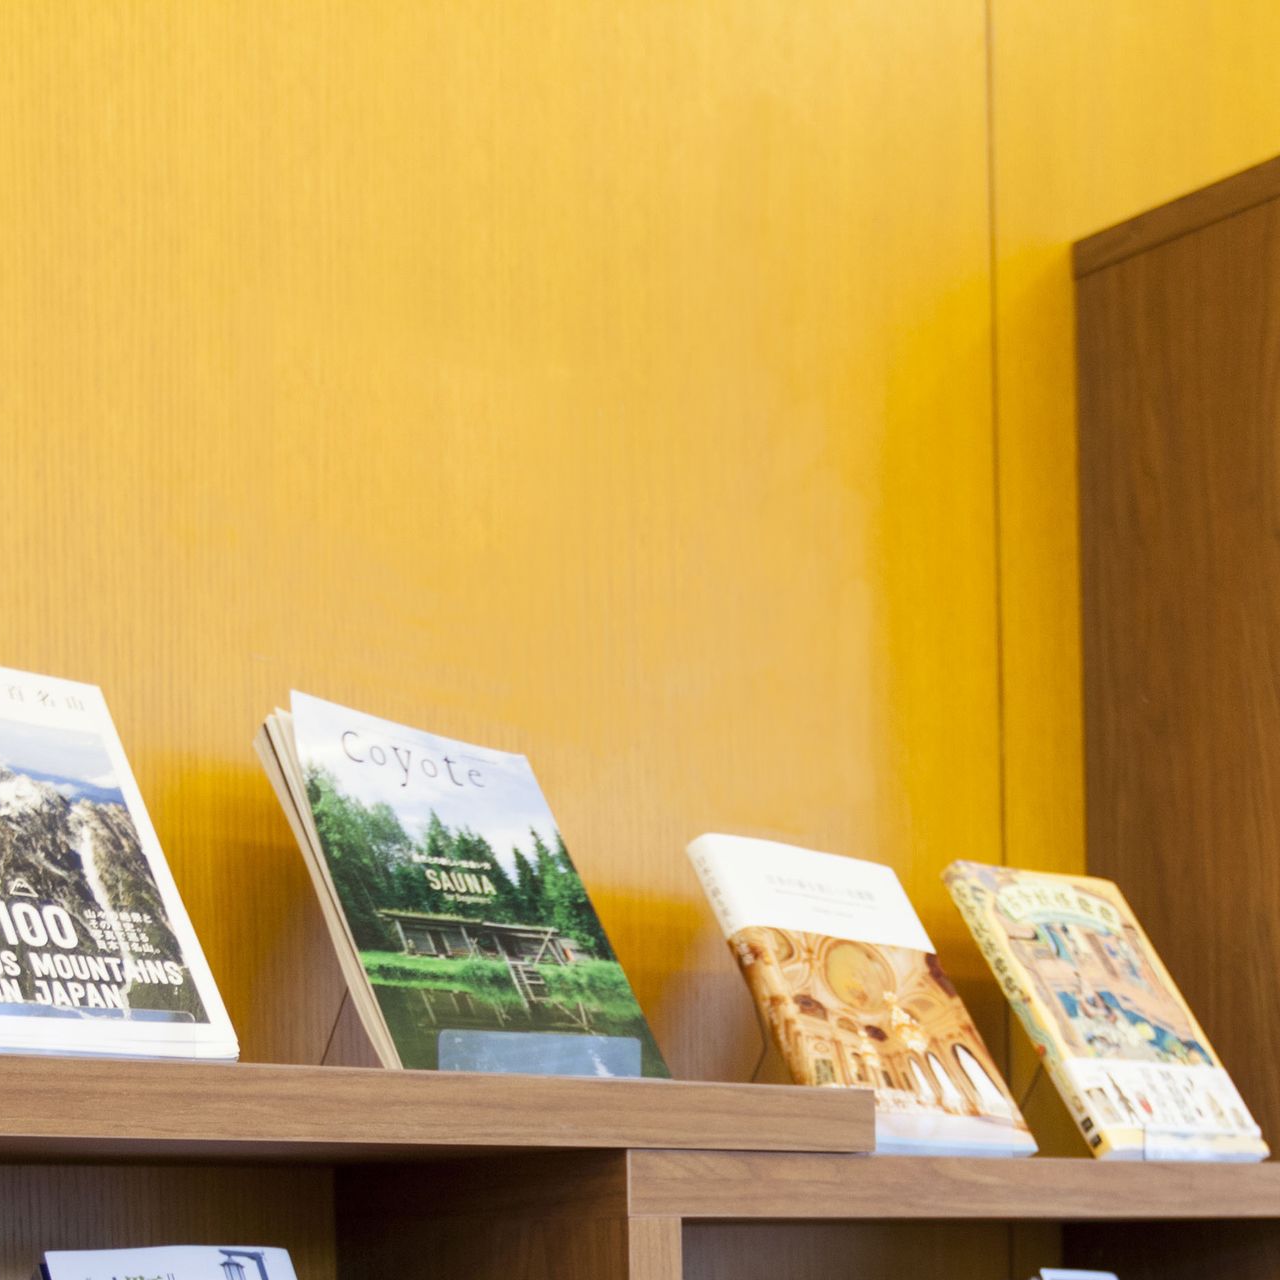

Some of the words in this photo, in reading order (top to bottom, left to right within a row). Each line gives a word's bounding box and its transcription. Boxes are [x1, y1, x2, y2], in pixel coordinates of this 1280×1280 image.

[340, 729, 486, 789] Coyote
[424, 868, 498, 896] SAUNA
[31, 954, 185, 987] MOUNTAINS
[32, 980, 131, 1010] JAPAN
